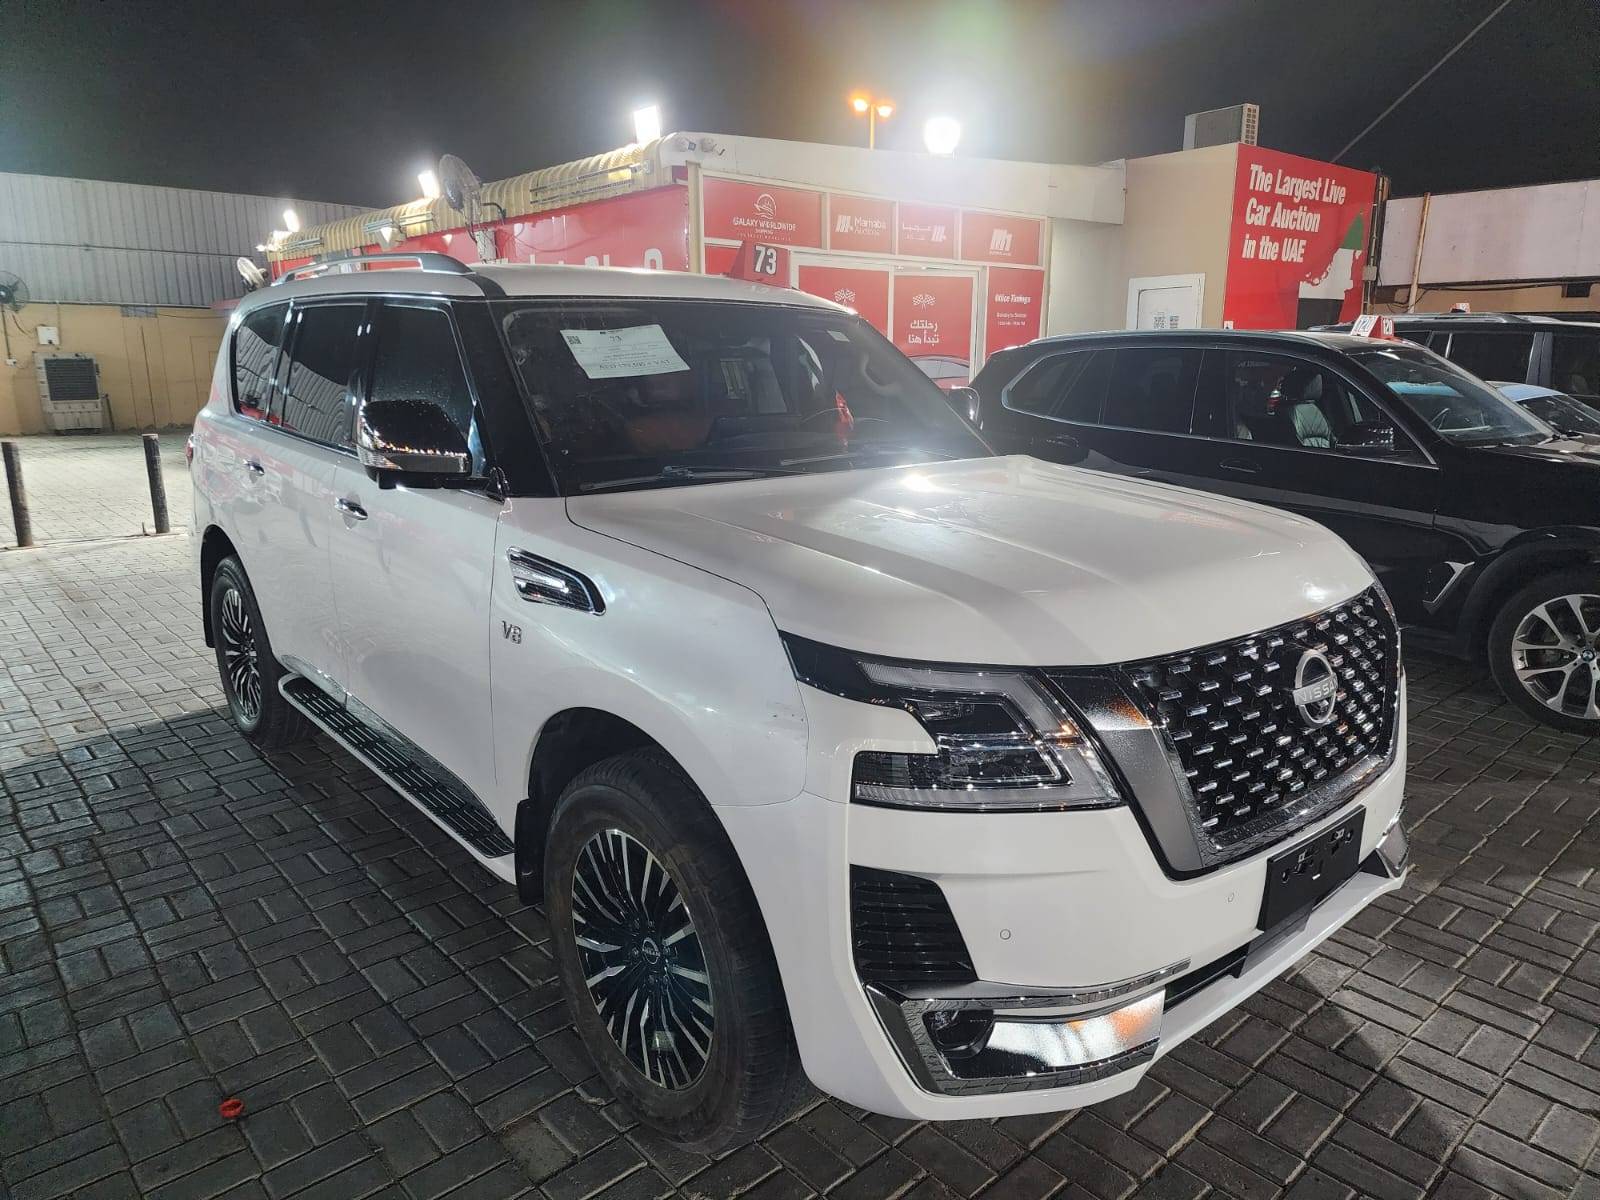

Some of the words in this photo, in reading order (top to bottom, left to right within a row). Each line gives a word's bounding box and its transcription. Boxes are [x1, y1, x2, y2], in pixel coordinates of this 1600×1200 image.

[1250, 163, 1272, 192] The
[1275, 169, 1322, 203] Largest
[1323, 179, 1346, 205] Live
[733, 217, 758, 227] GALAXY
[1246, 197, 1270, 227] Car
[1271, 203, 1320, 233] Auction
[755, 245, 777, 275] 73
[1242, 233, 1257, 259] in
[1259, 235, 1279, 261] the
[1281, 238, 1306, 263] UAE
[910, 319, 938, 332] رحلتك
[908, 333, 922, 345] هنا
[923, 330, 939, 347] تبدأ
[502, 620, 522, 644] V8
